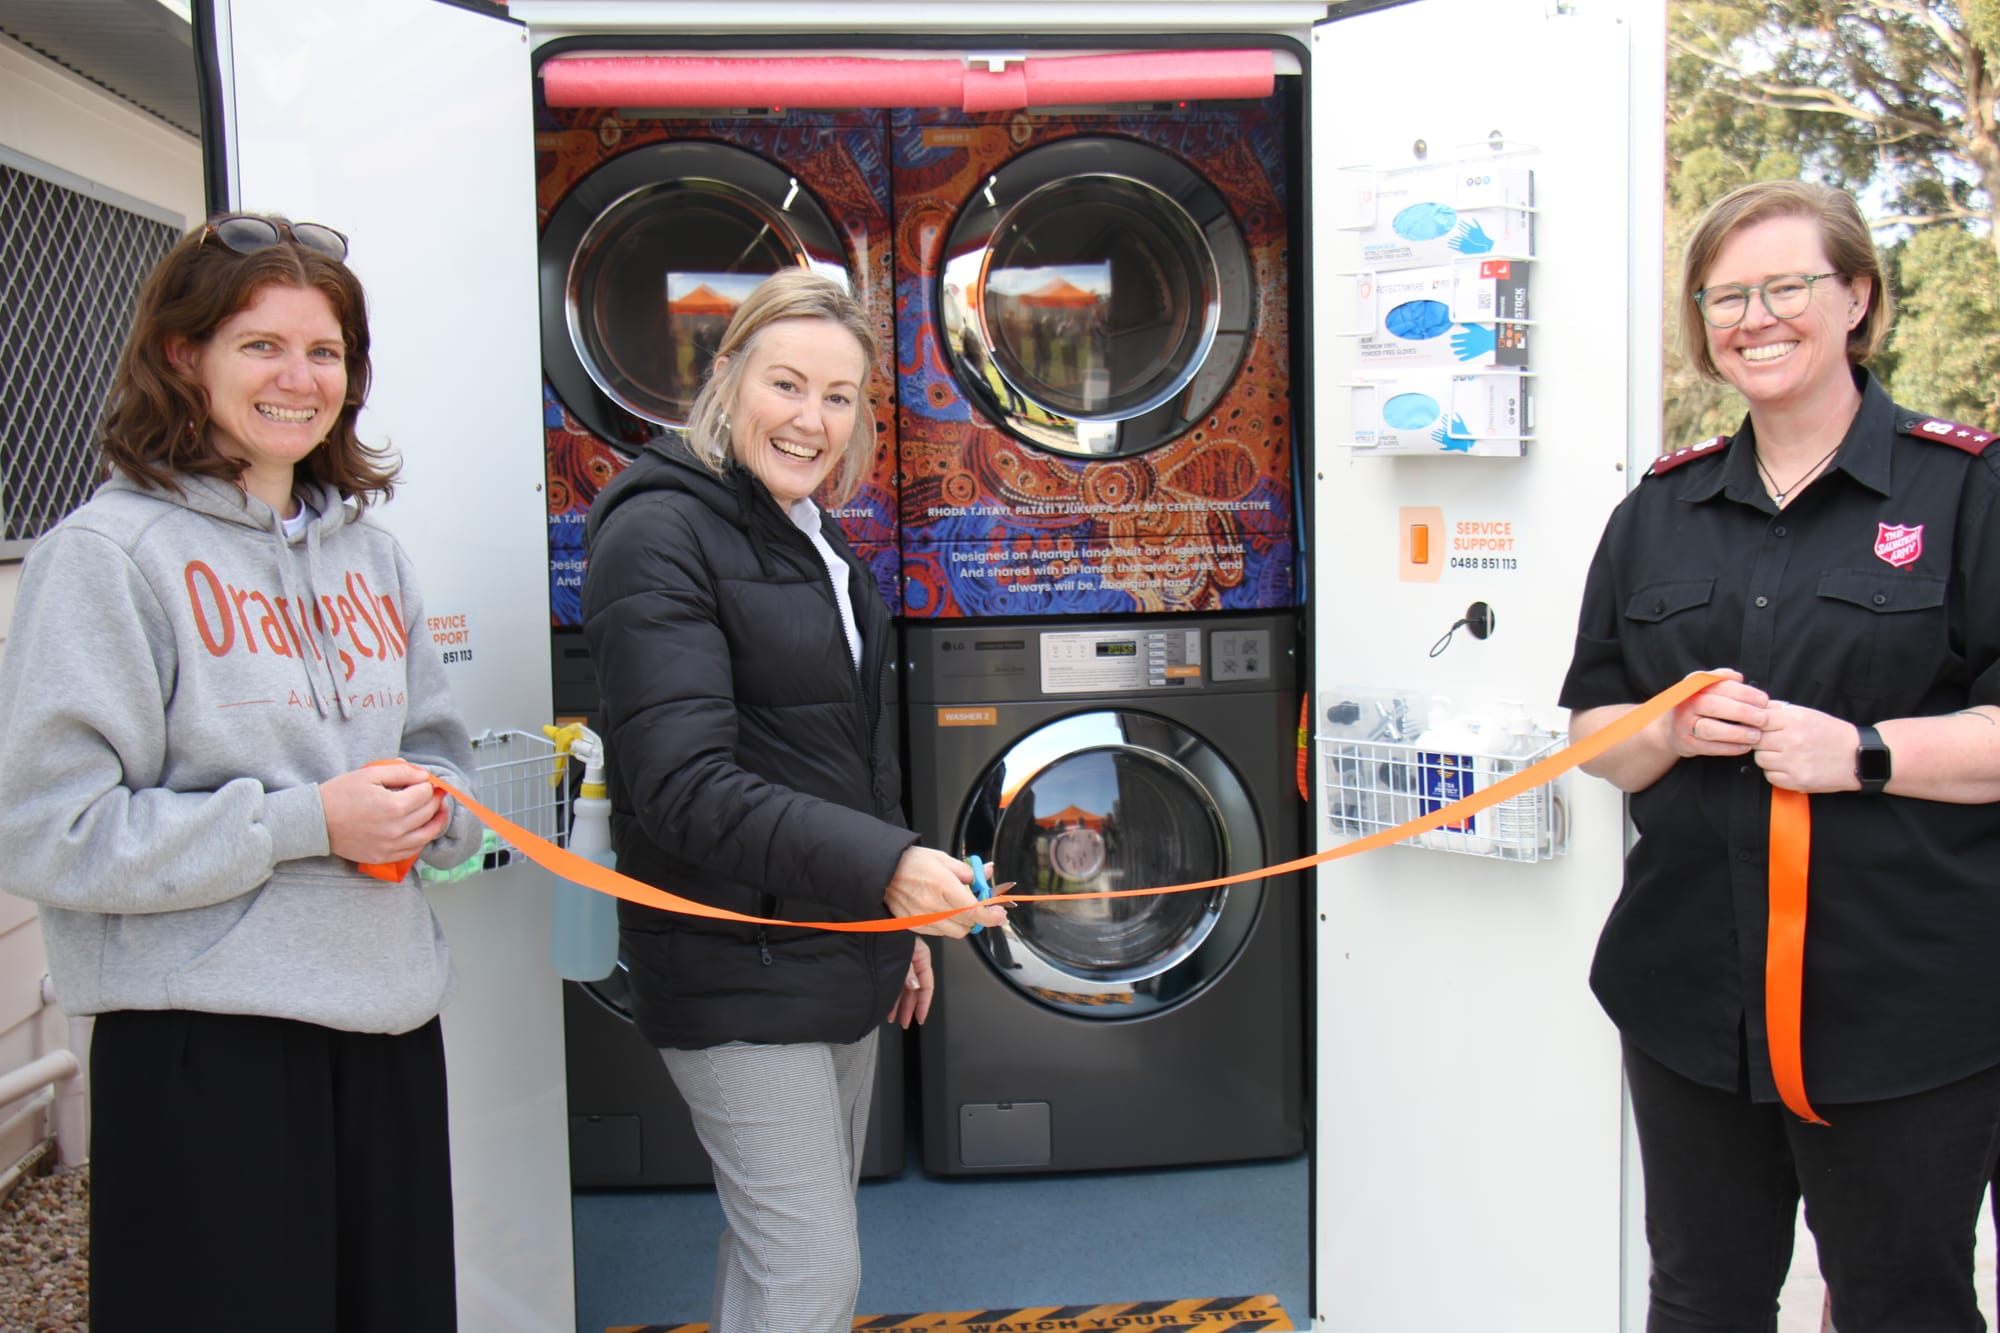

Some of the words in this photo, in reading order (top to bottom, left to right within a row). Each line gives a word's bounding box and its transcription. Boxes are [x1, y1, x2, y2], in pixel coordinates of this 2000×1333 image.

[1514, 287, 1526, 331] RSTOCK
[927, 506, 967, 517] RHODA
[1119, 503, 1140, 513] APY
[1144, 502, 1164, 513] ART
[1168, 502, 1208, 512] CENTRE
[1209, 501, 1271, 512] COLLECTIVE
[1456, 522, 1512, 536] SERVICE
[1453, 537, 1515, 551] SUPPORT
[951, 550, 1009, 564] Designed
[1012, 552, 1028, 560] on
[1116, 547, 1142, 557] Built
[1145, 548, 1161, 556] on
[1217, 543, 1247, 555] land.
[959, 568, 985, 578] And
[987, 566, 1030, 577] shared
[1033, 565, 1060, 576] with
[1062, 564, 1078, 575] all
[1081, 563, 1114, 574] lands
[1117, 562, 1142, 573] that
[1144, 560, 1187, 574] always
[1220, 560, 1243, 570] and
[1450, 557, 1479, 568] 0488
[1481, 558, 1500, 569] 851
[1502, 558, 1518, 570] 113
[556, 576, 582, 586] And
[1007, 581, 1051, 594] always
[1054, 580, 1075, 590] will
[1099, 577, 1161, 591] Aboriginal
[427, 614, 466, 631] ERVICE
[432, 629, 470, 646] PPORT
[443, 651, 459, 665] 851
[459, 649, 473, 662] 113
[945, 712, 983, 721] WASHER
[984, 711, 991, 721] 2
[966, 1319, 1079, 1333] WATCH
[1089, 1314, 1178, 1328] YOUR
[1188, 1309, 1268, 1323] STEP
